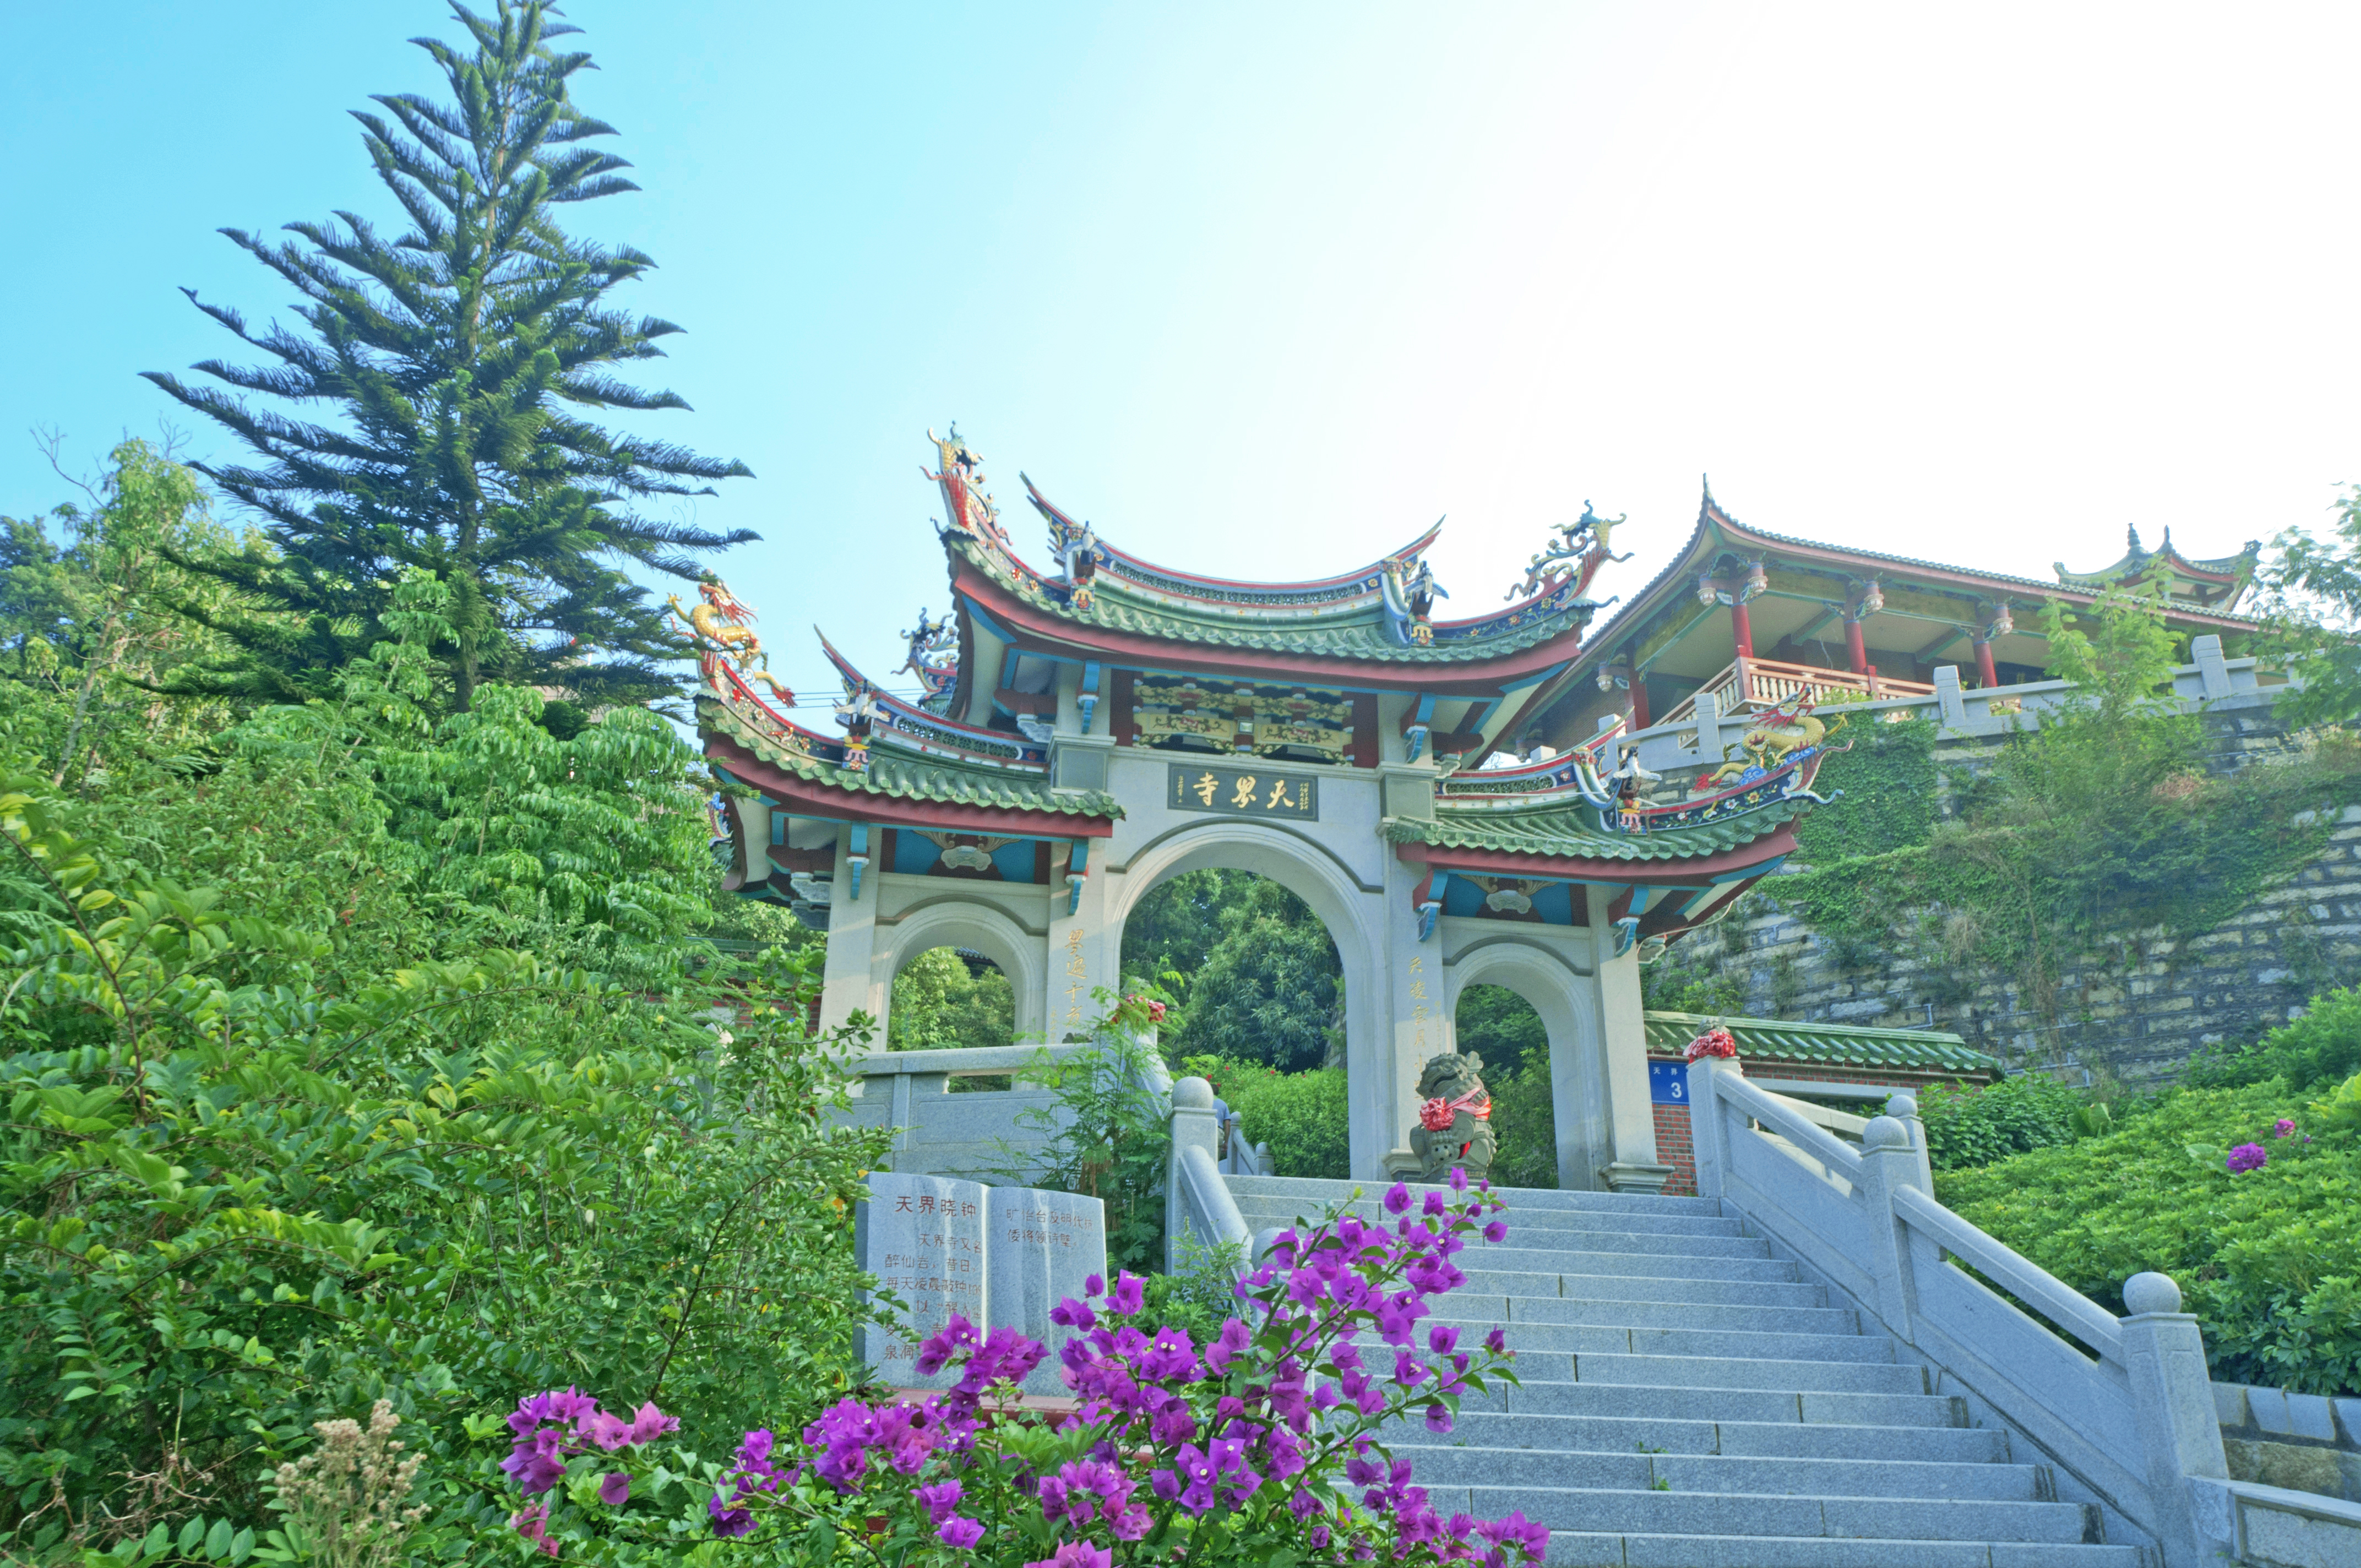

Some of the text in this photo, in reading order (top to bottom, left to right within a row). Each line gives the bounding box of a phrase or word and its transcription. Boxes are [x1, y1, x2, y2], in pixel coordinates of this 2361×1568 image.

[1193, 772, 1294, 809] 天界寺
[1671, 1082, 1682, 1098] 3
[895, 1196, 976, 1219] 天界晓钟
[1007, 1208, 1094, 1231] 旷怡台及明代抗
[918, 1233, 981, 1254] 天界寺又名
